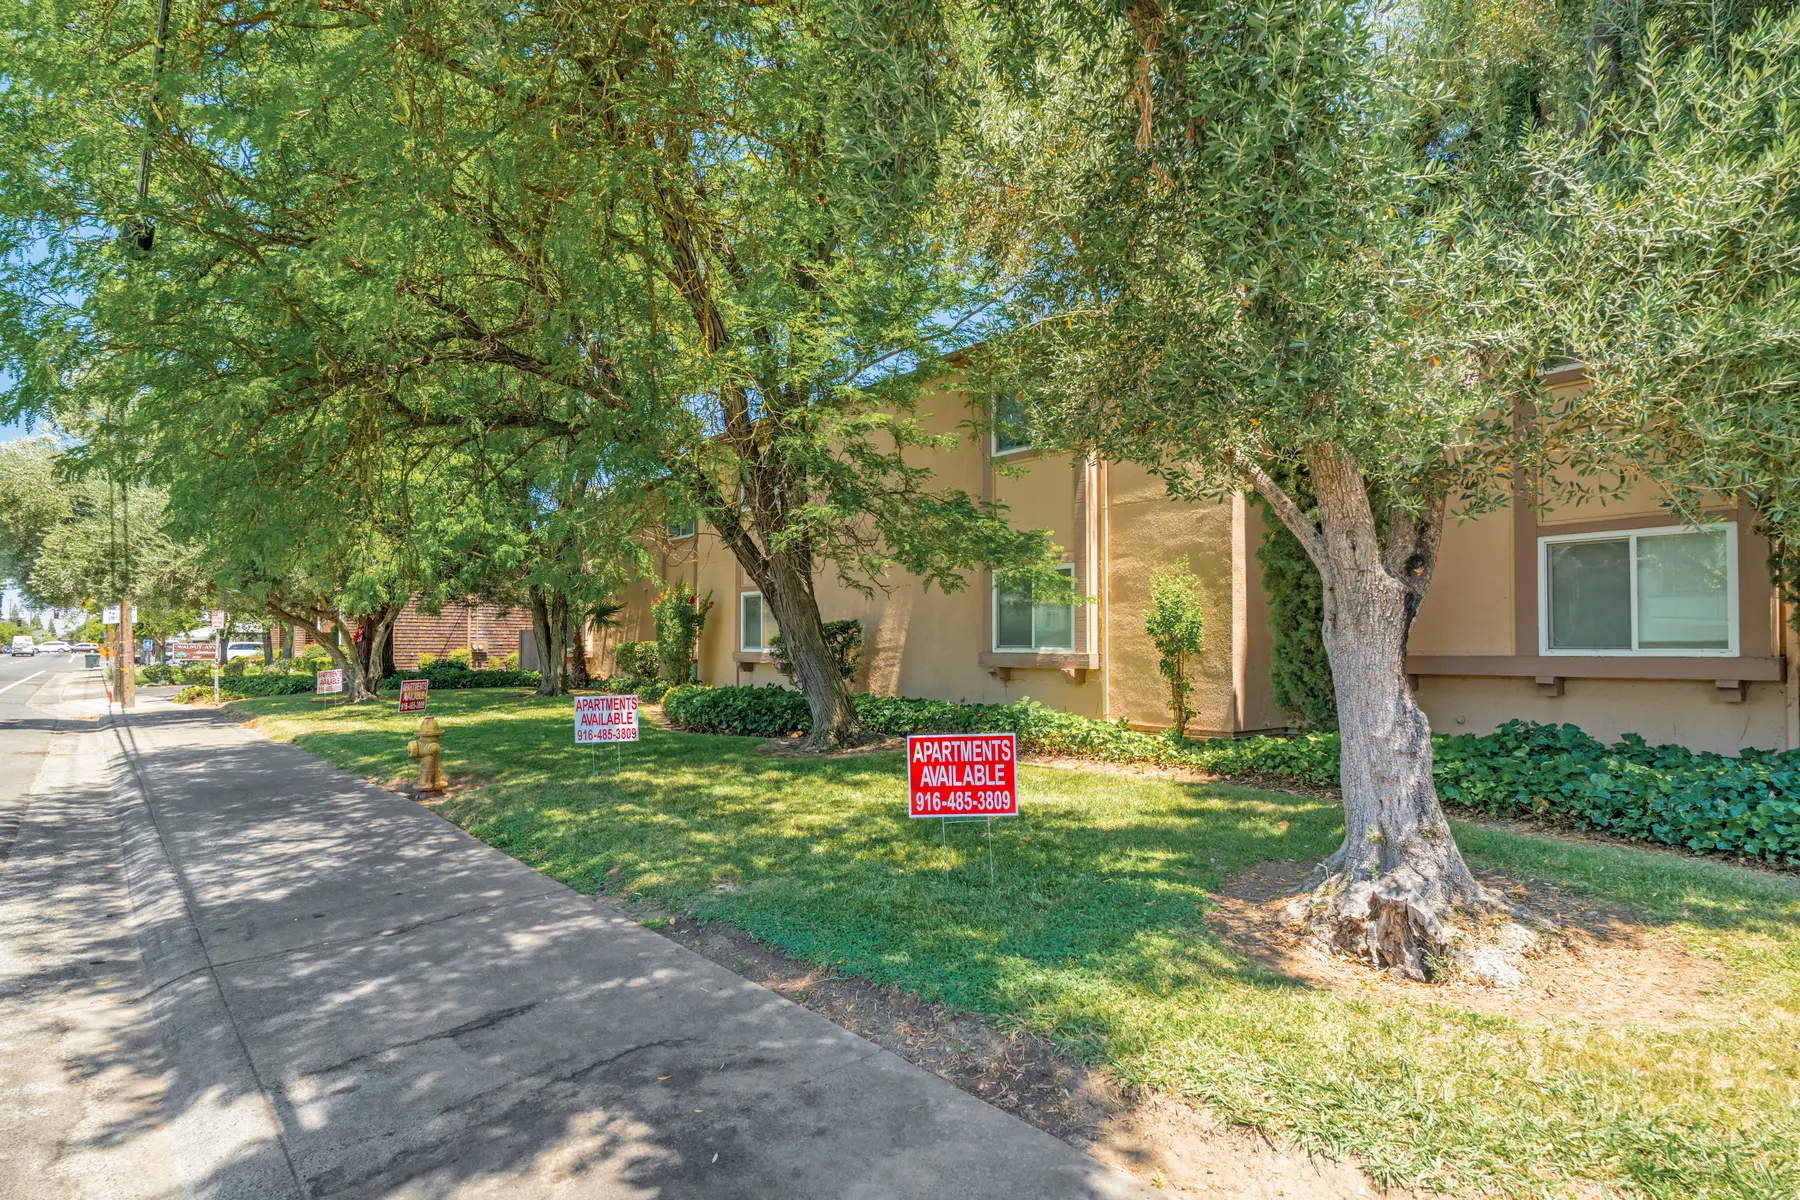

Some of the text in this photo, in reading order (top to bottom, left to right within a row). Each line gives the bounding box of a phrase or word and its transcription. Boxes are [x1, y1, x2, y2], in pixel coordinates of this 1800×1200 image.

[576, 697, 637, 711] APARTMENTS
[581, 712, 633, 726] AVAILABLE
[577, 728, 637, 741] 916-485-3809
[913, 739, 1011, 763] APARTMENTS
[920, 764, 1006, 787] AVAILABLE
[916, 790, 1011, 811] 916-485-3809
